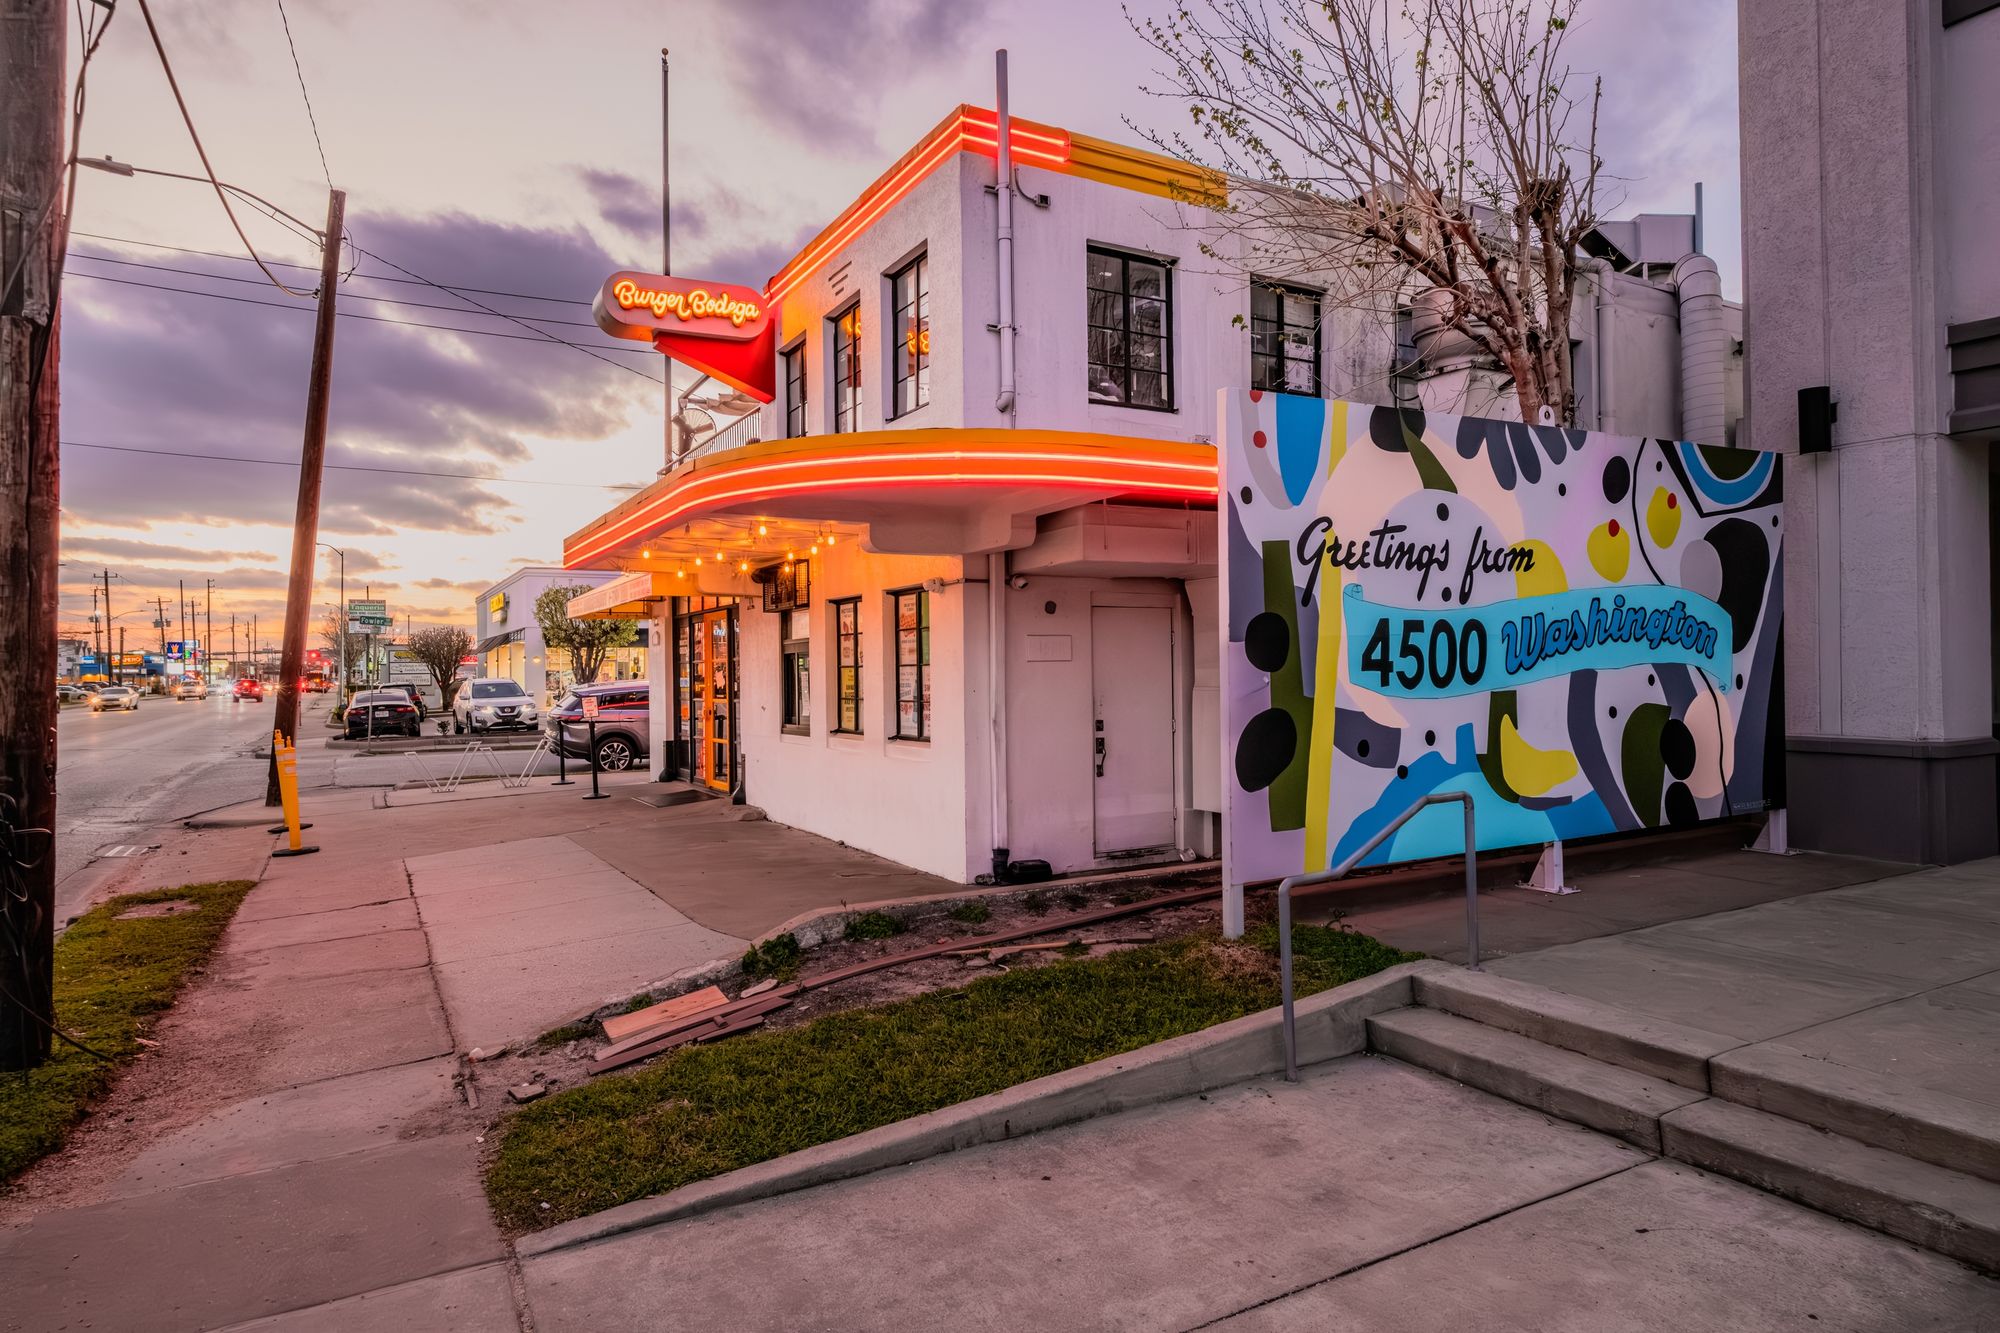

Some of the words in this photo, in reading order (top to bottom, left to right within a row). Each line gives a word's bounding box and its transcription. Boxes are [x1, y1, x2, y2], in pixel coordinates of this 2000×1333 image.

[614, 279, 692, 320] Burger
[687, 289, 760, 327] Bodega
[1297, 516, 1450, 607] Greetings
[1459, 526, 1536, 605] from
[361, 616, 384, 625] Fowler
[1361, 617, 1488, 690] 4500
[1501, 594, 1718, 675] Washington
